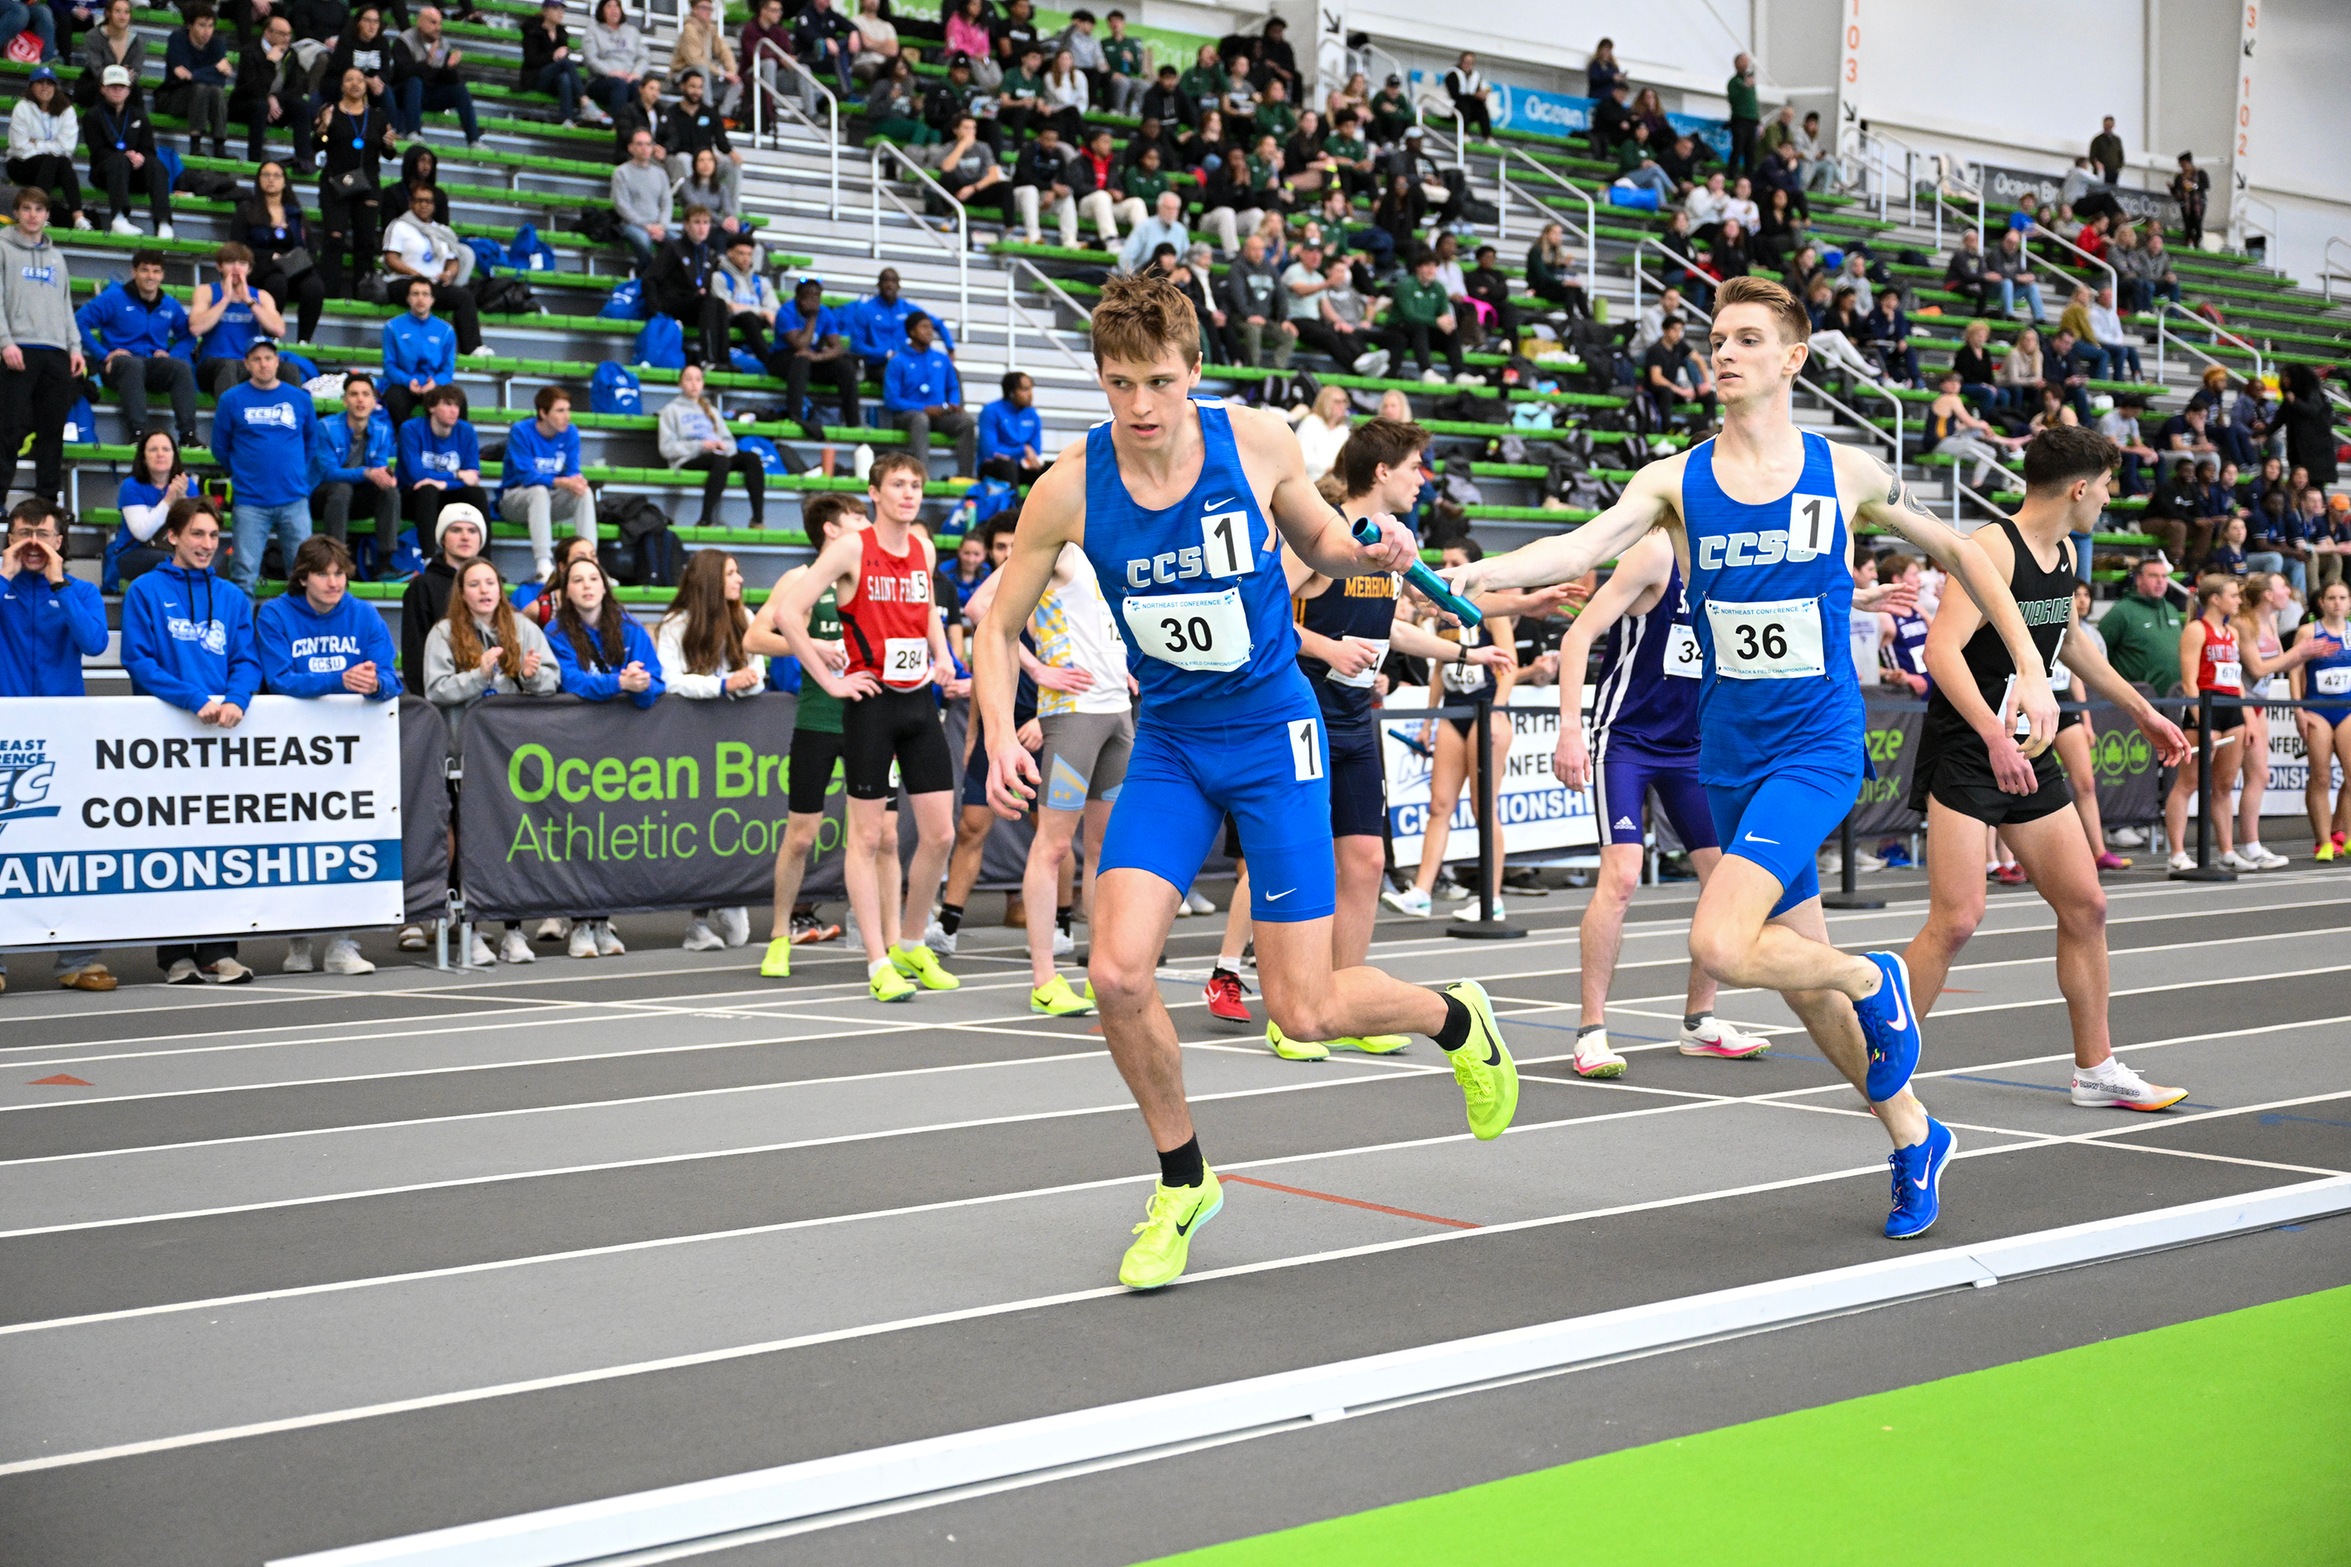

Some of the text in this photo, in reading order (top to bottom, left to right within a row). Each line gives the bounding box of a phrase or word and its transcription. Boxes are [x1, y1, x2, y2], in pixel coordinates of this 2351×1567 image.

[2238, 75, 2251, 157] 102
[1802, 499, 1821, 549] 1
[1213, 517, 1238, 572] 1
[917, 573, 927, 599] 5
[1126, 545, 1213, 589] CCS
[867, 575, 897, 601] SAINT
[1180, 599, 1221, 608] CONFERENCE
[1721, 606, 1799, 616] NORTHEAST CONFERENCE
[1160, 616, 1213, 653] 30
[1735, 623, 1788, 660] 36
[895, 650, 922, 669] 284
[0, 753, 46, 765] ENCE
[95, 735, 360, 770] NORTHEAST
[1300, 723, 1315, 776] 1
[508, 743, 699, 802] Ocean
[82, 790, 375, 829] CONFERENCE
[507, 810, 698, 862] Athletic
[2, 843, 379, 895] AMPIONSHIPS
